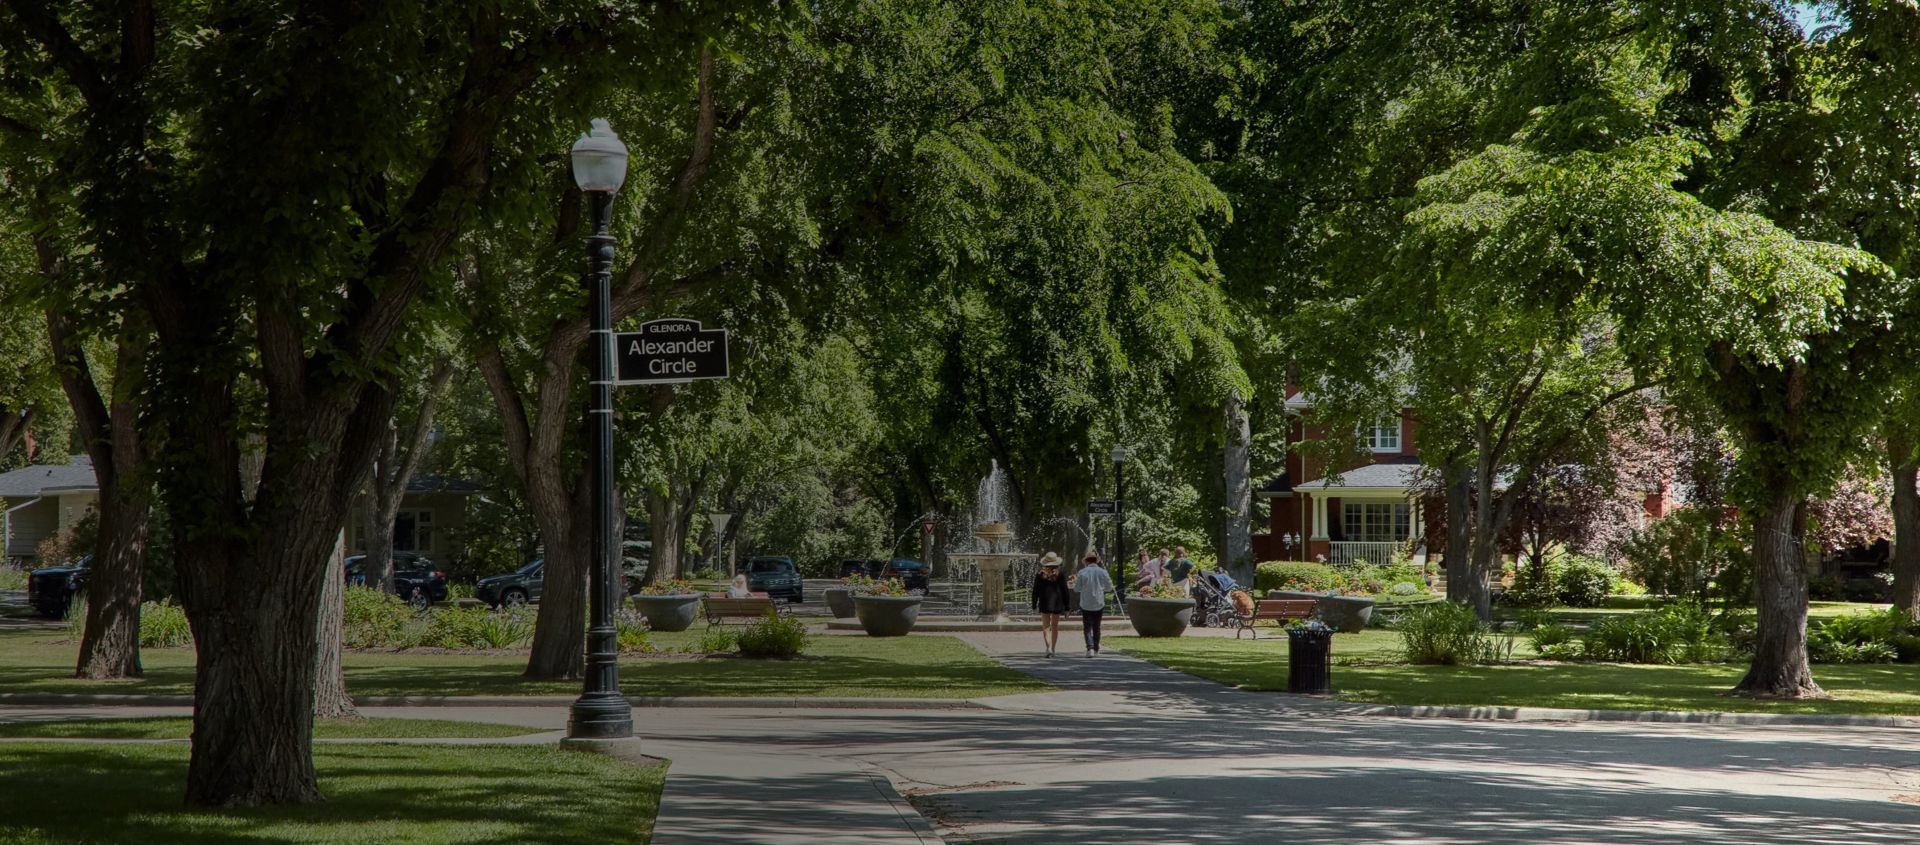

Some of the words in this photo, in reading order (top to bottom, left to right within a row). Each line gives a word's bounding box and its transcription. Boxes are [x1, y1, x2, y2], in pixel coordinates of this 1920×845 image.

[650, 324, 692, 333] GLENORA
[629, 337, 714, 355] Alexander
[649, 358, 696, 374] Circle
